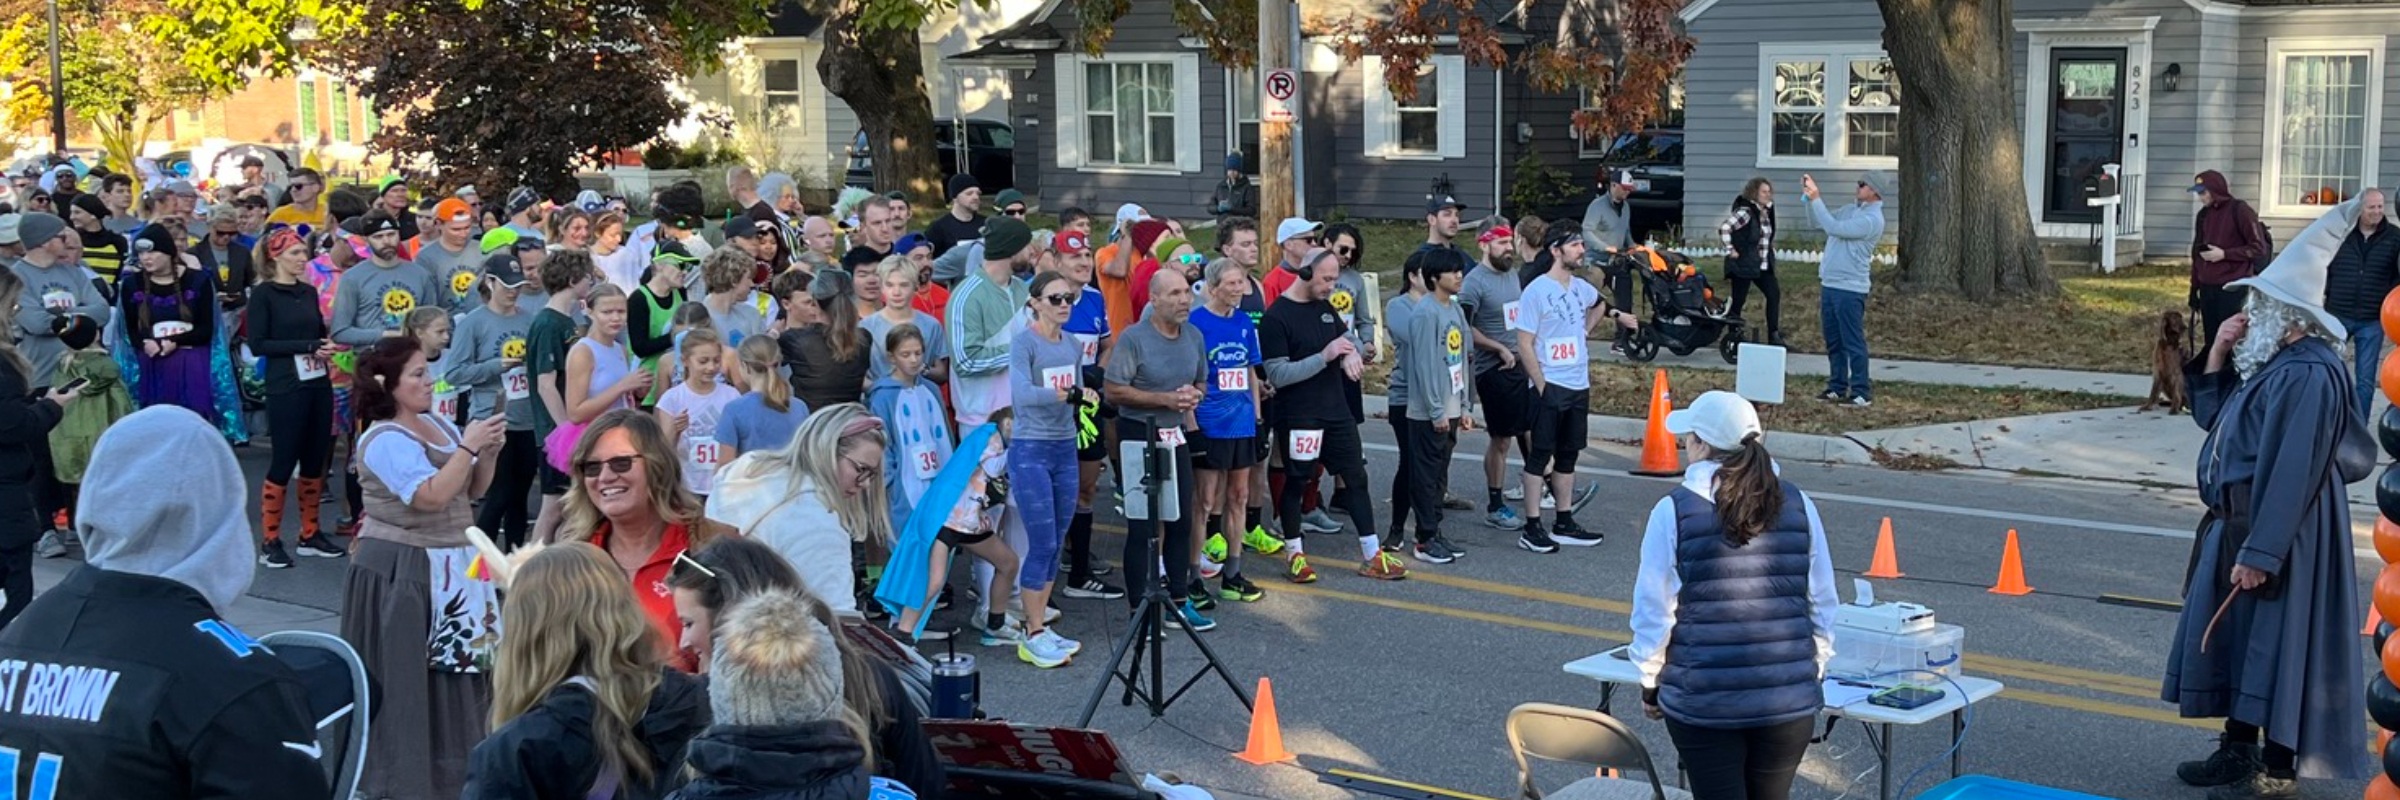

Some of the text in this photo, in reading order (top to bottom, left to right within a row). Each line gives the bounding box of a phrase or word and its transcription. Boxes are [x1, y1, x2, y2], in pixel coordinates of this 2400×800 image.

[2131, 65, 2141, 110] 823
[1551, 342, 1576, 360] 284
[1219, 371, 1244, 388] 376
[438, 399, 456, 416] 40
[696, 444, 717, 463] 51
[1296, 437, 1319, 454] 524
[920, 451, 937, 471] 39
[0, 659, 121, 723] ST BROWN
